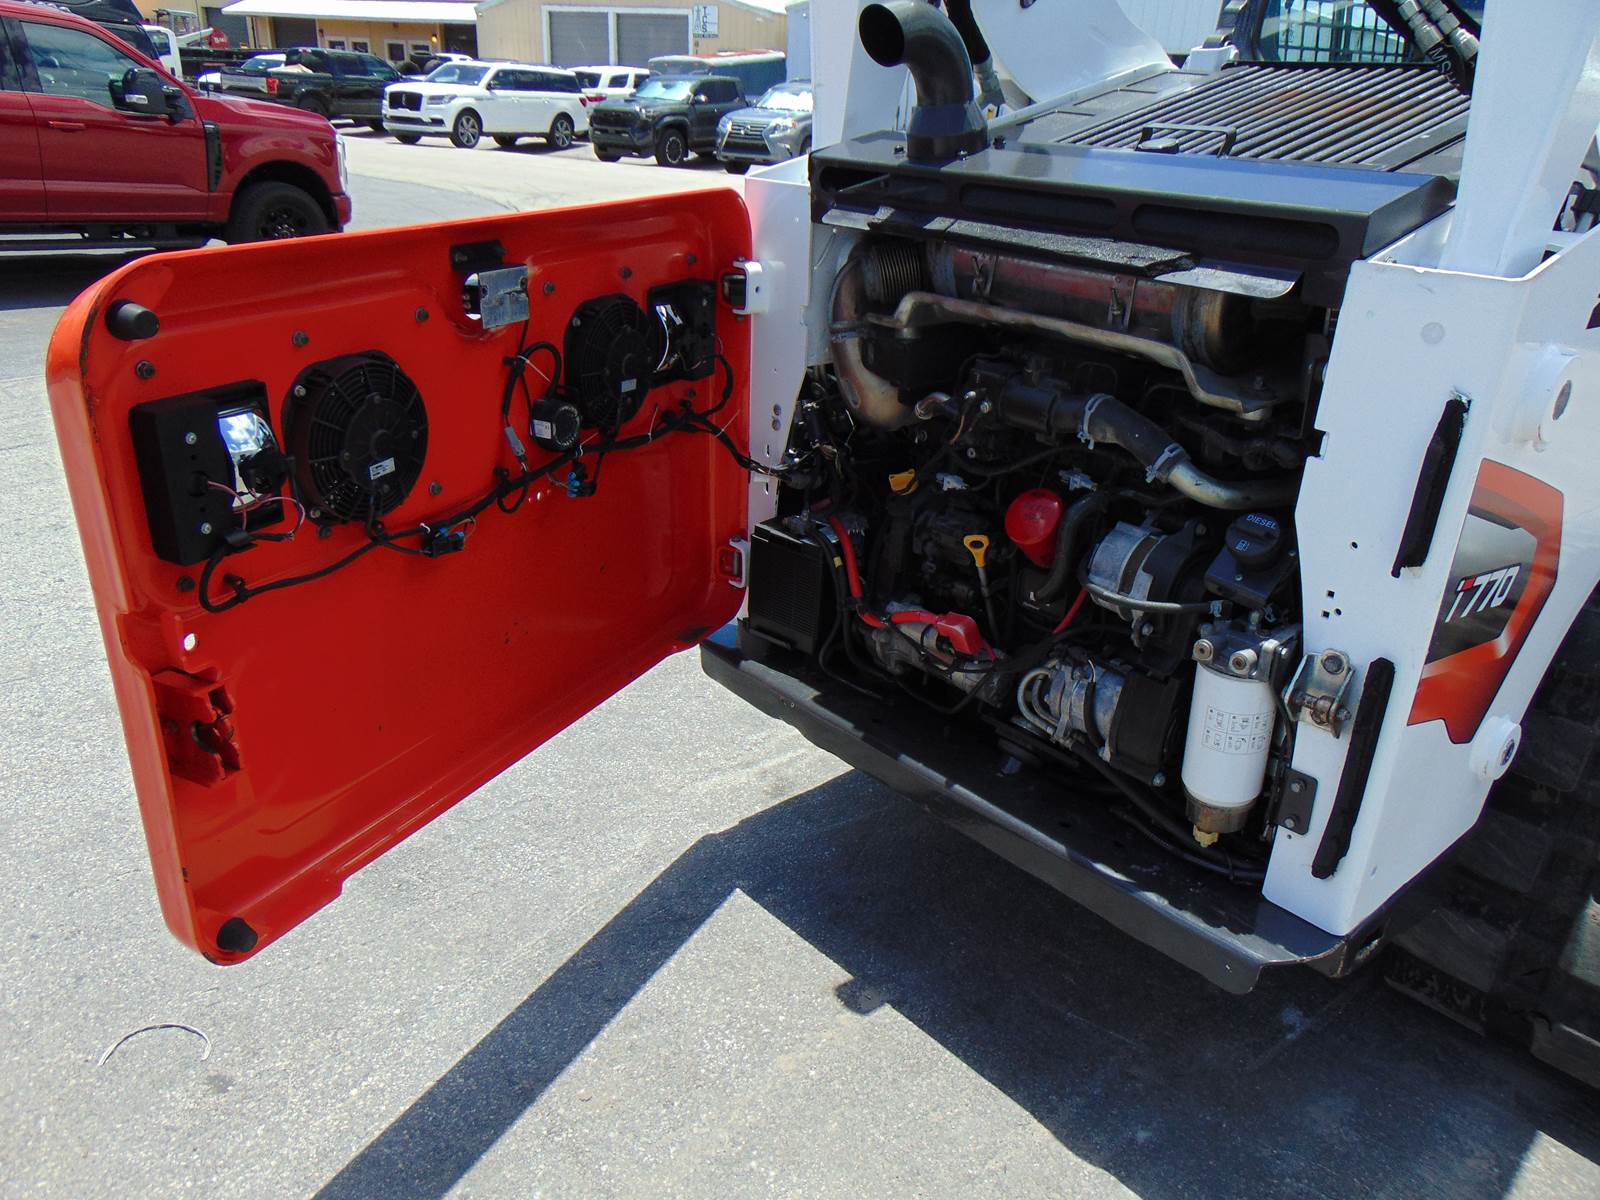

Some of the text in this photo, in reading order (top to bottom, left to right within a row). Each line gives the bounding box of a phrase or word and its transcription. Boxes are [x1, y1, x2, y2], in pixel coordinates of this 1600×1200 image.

[1429, 47, 1459, 86] MSH
[1246, 513, 1276, 530] DIESEL
[1444, 566, 1520, 624] T770
